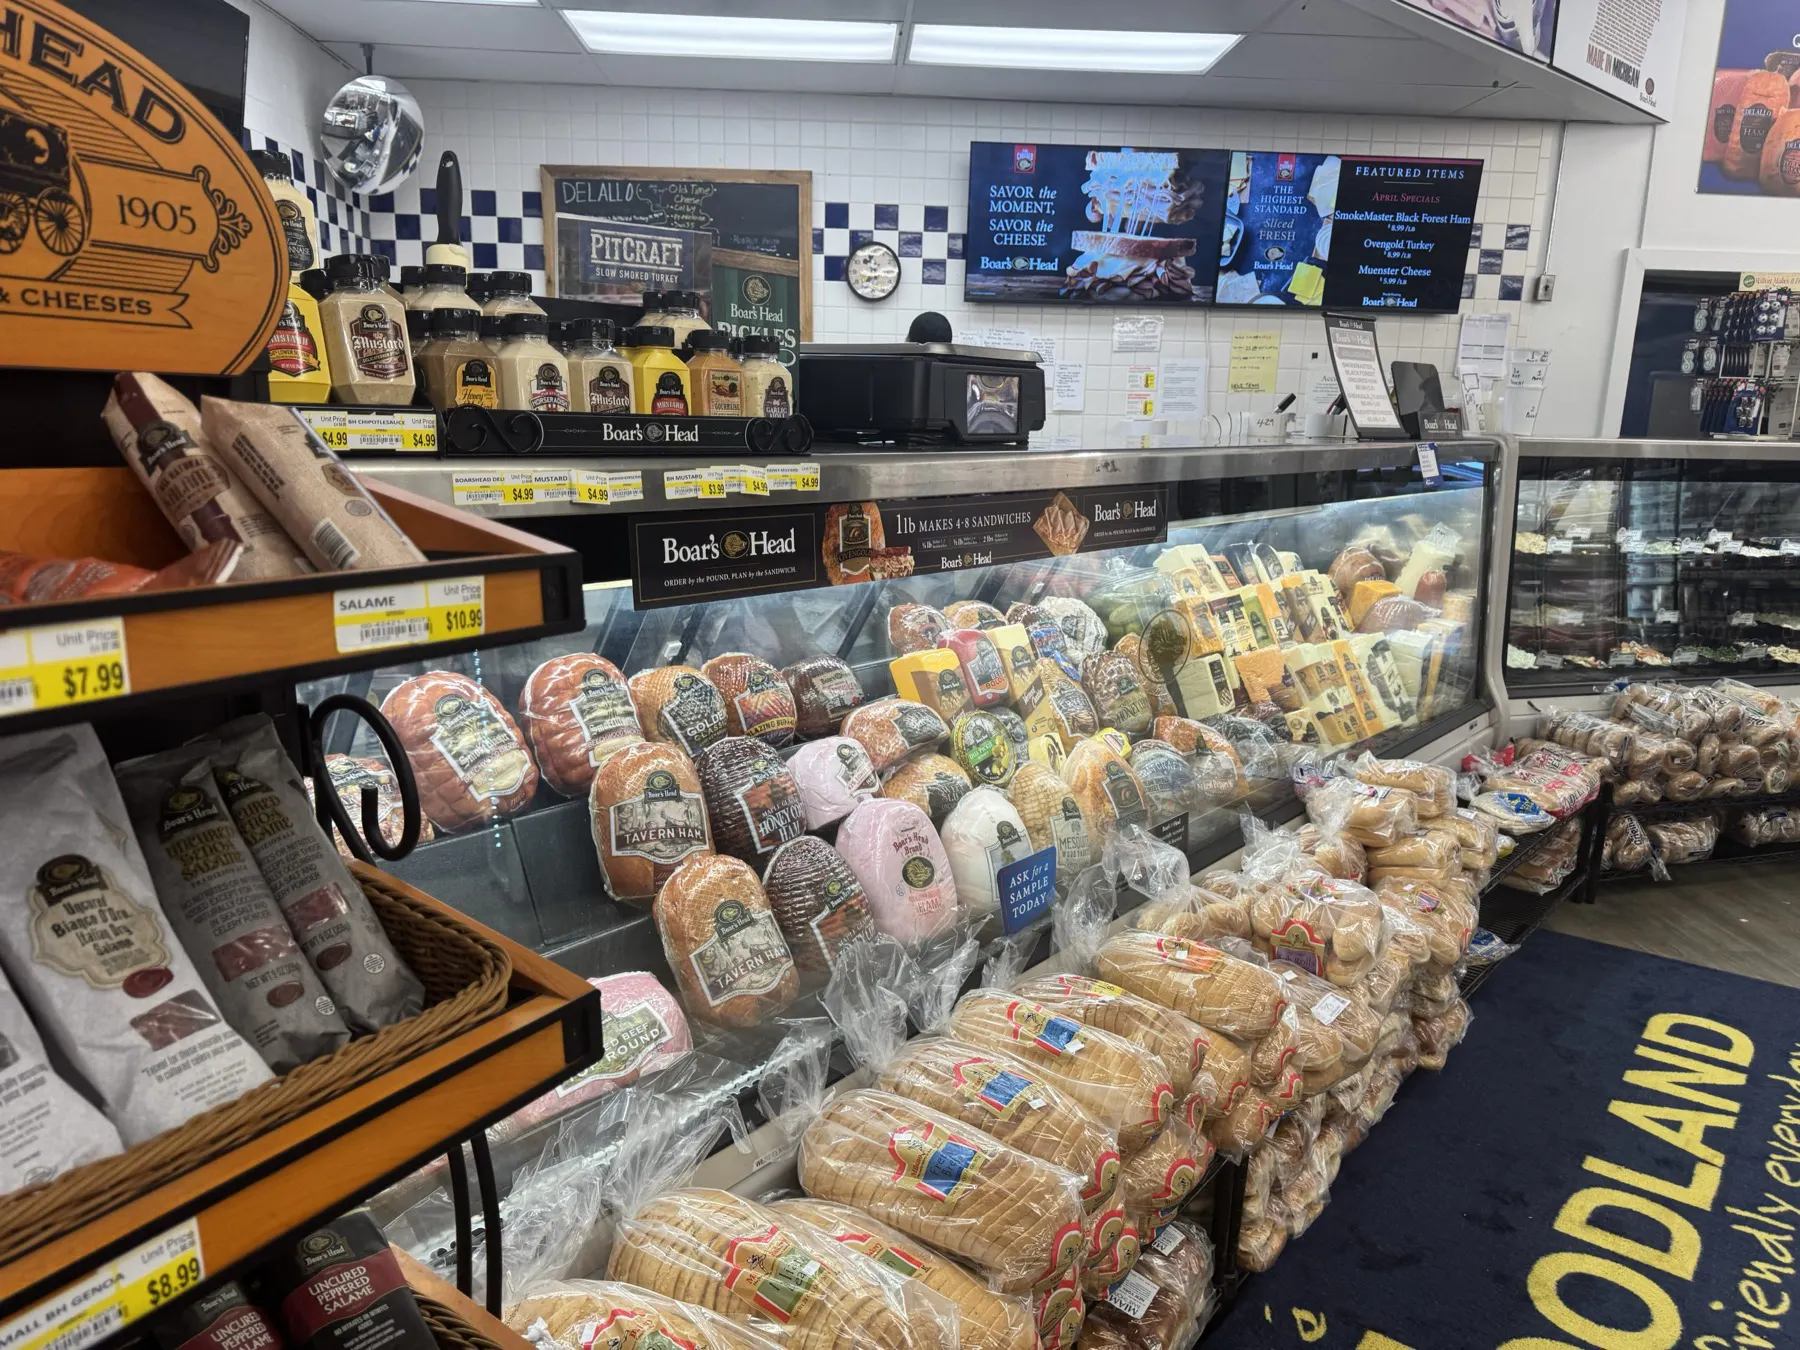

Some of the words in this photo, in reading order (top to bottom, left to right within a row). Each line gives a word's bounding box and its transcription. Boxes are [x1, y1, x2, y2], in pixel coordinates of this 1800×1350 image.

[1586, 43, 1605, 71] MADE
[1604, 53, 1612, 75] IN
[1611, 57, 1640, 88] MICHIGAN
[1355, 166, 1421, 178] FEATURED
[1426, 169, 1465, 179] ITEMS
[562, 182, 633, 204] DELALLO
[668, 184, 686, 194] Old
[690, 184, 711, 195] Time
[989, 185, 1033, 199] SAVOR
[1039, 186, 1057, 199] the
[1273, 185, 1293, 194] THE
[989, 200, 1055, 216] MOMENT,
[1260, 195, 1304, 205] HIGHEST
[116, 194, 198, 236] 1905
[1254, 205, 1307, 215] STANDARD
[1395, 211, 1418, 223] Black
[1421, 213, 1448, 224] Forest
[1450, 215, 1471, 224] Ham
[989, 219, 1032, 232] SAVOR
[1036, 219, 1053, 233] the
[1264, 218, 1294, 229] Sliced
[1259, 231, 1296, 241] FRESH
[1406, 241, 1435, 253] Turkey
[980, 256, 1011, 270] Boar's
[1029, 257, 1058, 271] Head
[1254, 261, 1274, 270] Boar's
[1274, 262, 1293, 270] Head
[1358, 265, 1400, 276] Muenster
[1400, 266, 1431, 276] Cheese
[595, 267, 617, 278] SLOW
[619, 269, 650, 281] SMOKED
[651, 272, 679, 284] TURKEY
[20, 287, 153, 316] CHEESES
[1362, 297, 1384, 307] Boar's
[1396, 297, 1418, 308] Head
[730, 303, 758, 321] Boar's
[758, 306, 784, 324] Head
[351, 335, 405, 350] Mustard
[461, 388, 484, 401] Honey
[590, 393, 630, 406] Mustard
[321, 415, 332, 423] Unit
[333, 415, 347, 423] Price
[766, 406, 788, 414] GARLIC
[602, 422, 643, 442] Boar's
[664, 423, 699, 442] Head
[1423, 419, 1438, 430] Boar's
[1444, 419, 1457, 430] Head
[322, 431, 348, 446] $4.99
[413, 433, 436, 447] $4.99
[675, 474, 703, 482] MUSTARD
[752, 480, 768, 493] $4.99
[801, 477, 819, 488] $4.99
[512, 488, 534, 502] $4.99
[588, 488, 609, 501] $4.99
[708, 484, 725, 495] $3.99
[1094, 501, 1121, 522] Boar's
[1134, 499, 1157, 518] Head
[918, 520, 954, 533] MAKES
[955, 519, 970, 530] 4-8
[971, 511, 1031, 528] SANDWICHES
[662, 533, 720, 564] Boar's
[749, 527, 796, 556] Head
[941, 555, 963, 569] Boar's
[973, 551, 992, 565] Head
[664, 578, 687, 587] ORDER
[688, 577, 695, 586] by
[696, 576, 705, 584] the
[706, 573, 731, 583] POUND,
[731, 571, 748, 580] PLAN
[748, 571, 755, 579] by
[755, 569, 764, 577] the
[444, 585, 460, 596] Unit
[461, 584, 481, 594] Price
[339, 595, 396, 611] SALAME
[446, 608, 483, 632] $10.99
[56, 632, 84, 646] Unit
[86, 629, 119, 641] Price
[63, 661, 125, 699] $7.99
[647, 791, 664, 800] Boar's
[663, 789, 678, 798] Head
[164, 814, 193, 832] Boar's
[193, 804, 219, 821] Head
[758, 808, 791, 837] HONEY
[624, 828, 679, 845] TAVERN
[679, 827, 704, 840] HAM
[778, 820, 801, 842] HAM
[893, 834, 912, 852] Boar's
[912, 832, 929, 844] Head
[904, 842, 923, 856] Brand
[1009, 872, 1030, 889] ASK
[1030, 867, 1042, 881] for
[1043, 862, 1050, 872] a
[51, 880, 78, 898] Boar's
[77, 873, 101, 888] Head
[1009, 875, 1049, 905] SAMPLE
[63, 894, 107, 918] Uncured
[1012, 894, 1047, 919] TODAY
[720, 922, 737, 935] Boar's
[736, 915, 751, 928] Head
[76, 929, 111, 948] Italian
[111, 923, 134, 938] Dry
[93, 938, 135, 958] Salame
[715, 954, 765, 989] TAVERN
[765, 945, 788, 963] HAM
[622, 1022, 650, 1040] BEEF
[605, 1027, 661, 1062] ROUND
[1496, 1013, 1754, 1350] ODLAND
[141, 1245, 165, 1265] Unit
[166, 1230, 194, 1250] Price
[305, 1254, 329, 1267] Boar's
[328, 1244, 345, 1259] Head
[147, 1257, 201, 1307] $8.99
[307, 1265, 367, 1297] UNCURED
[45, 1304, 67, 1323] BH
[71, 1272, 125, 1308] GENOA
[316, 1275, 371, 1306] PEPPERED
[323, 1283, 375, 1315] SALAME
[202, 1299, 221, 1312] Boar's
[220, 1289, 238, 1302] Head
[210, 1311, 261, 1344] UNCURED
[222, 1322, 267, 1350] PEPPERED
